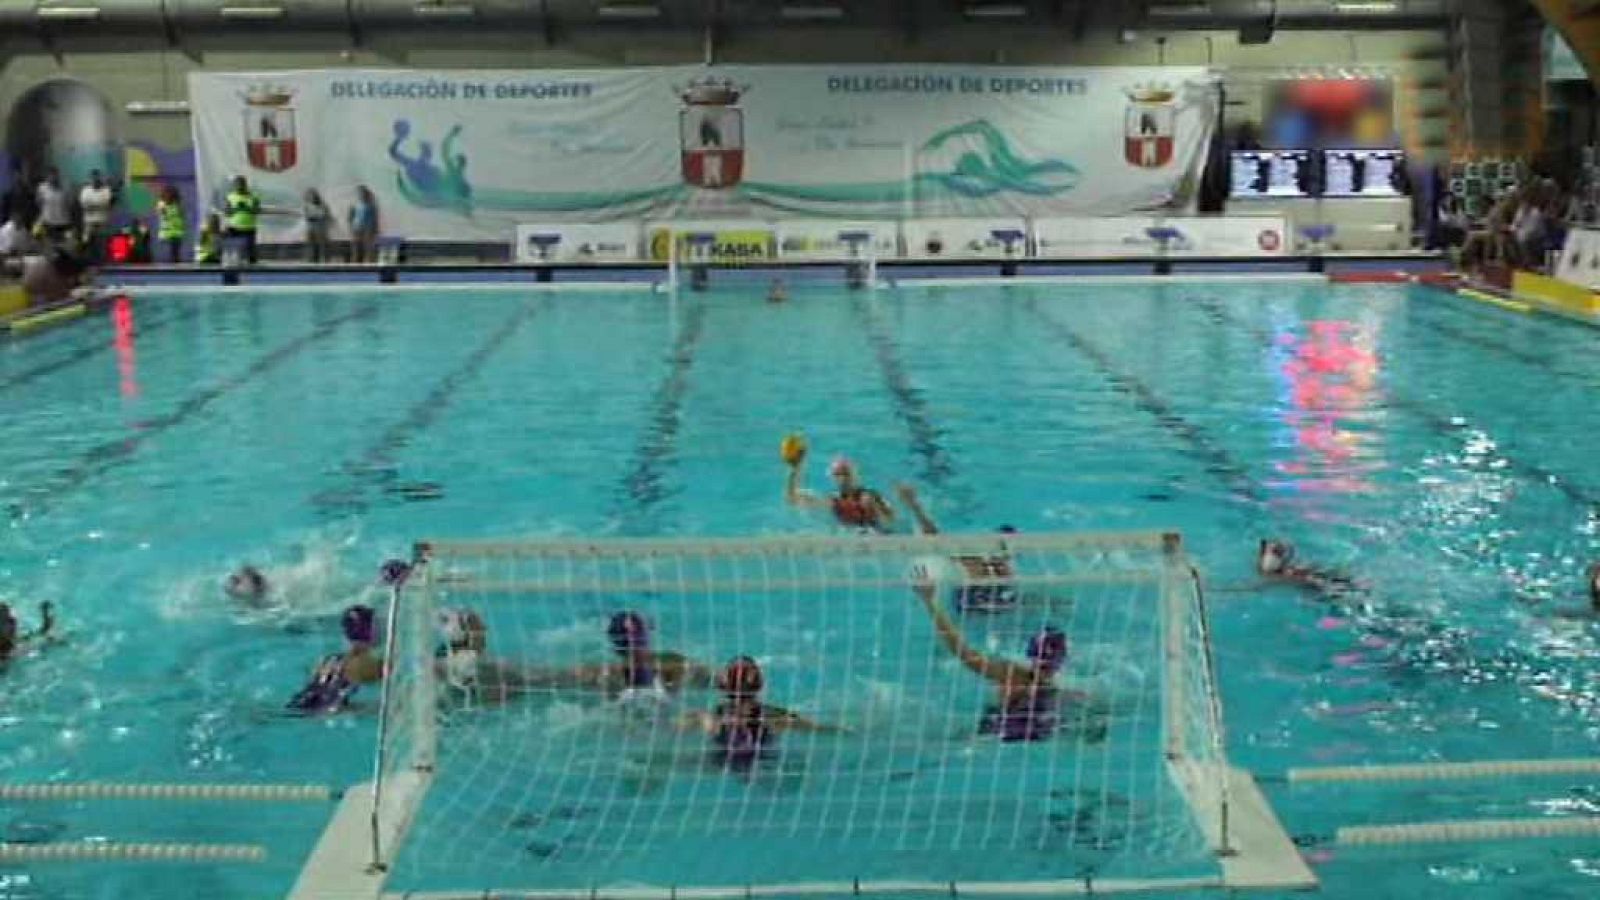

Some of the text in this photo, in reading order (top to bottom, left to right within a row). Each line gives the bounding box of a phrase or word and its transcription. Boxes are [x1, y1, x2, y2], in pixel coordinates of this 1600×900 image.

[330, 77, 593, 99] DELEGACIÓN DE DEPORTES
[959, 75, 983, 93] DE
[990, 76, 1088, 95] DEPORTES
